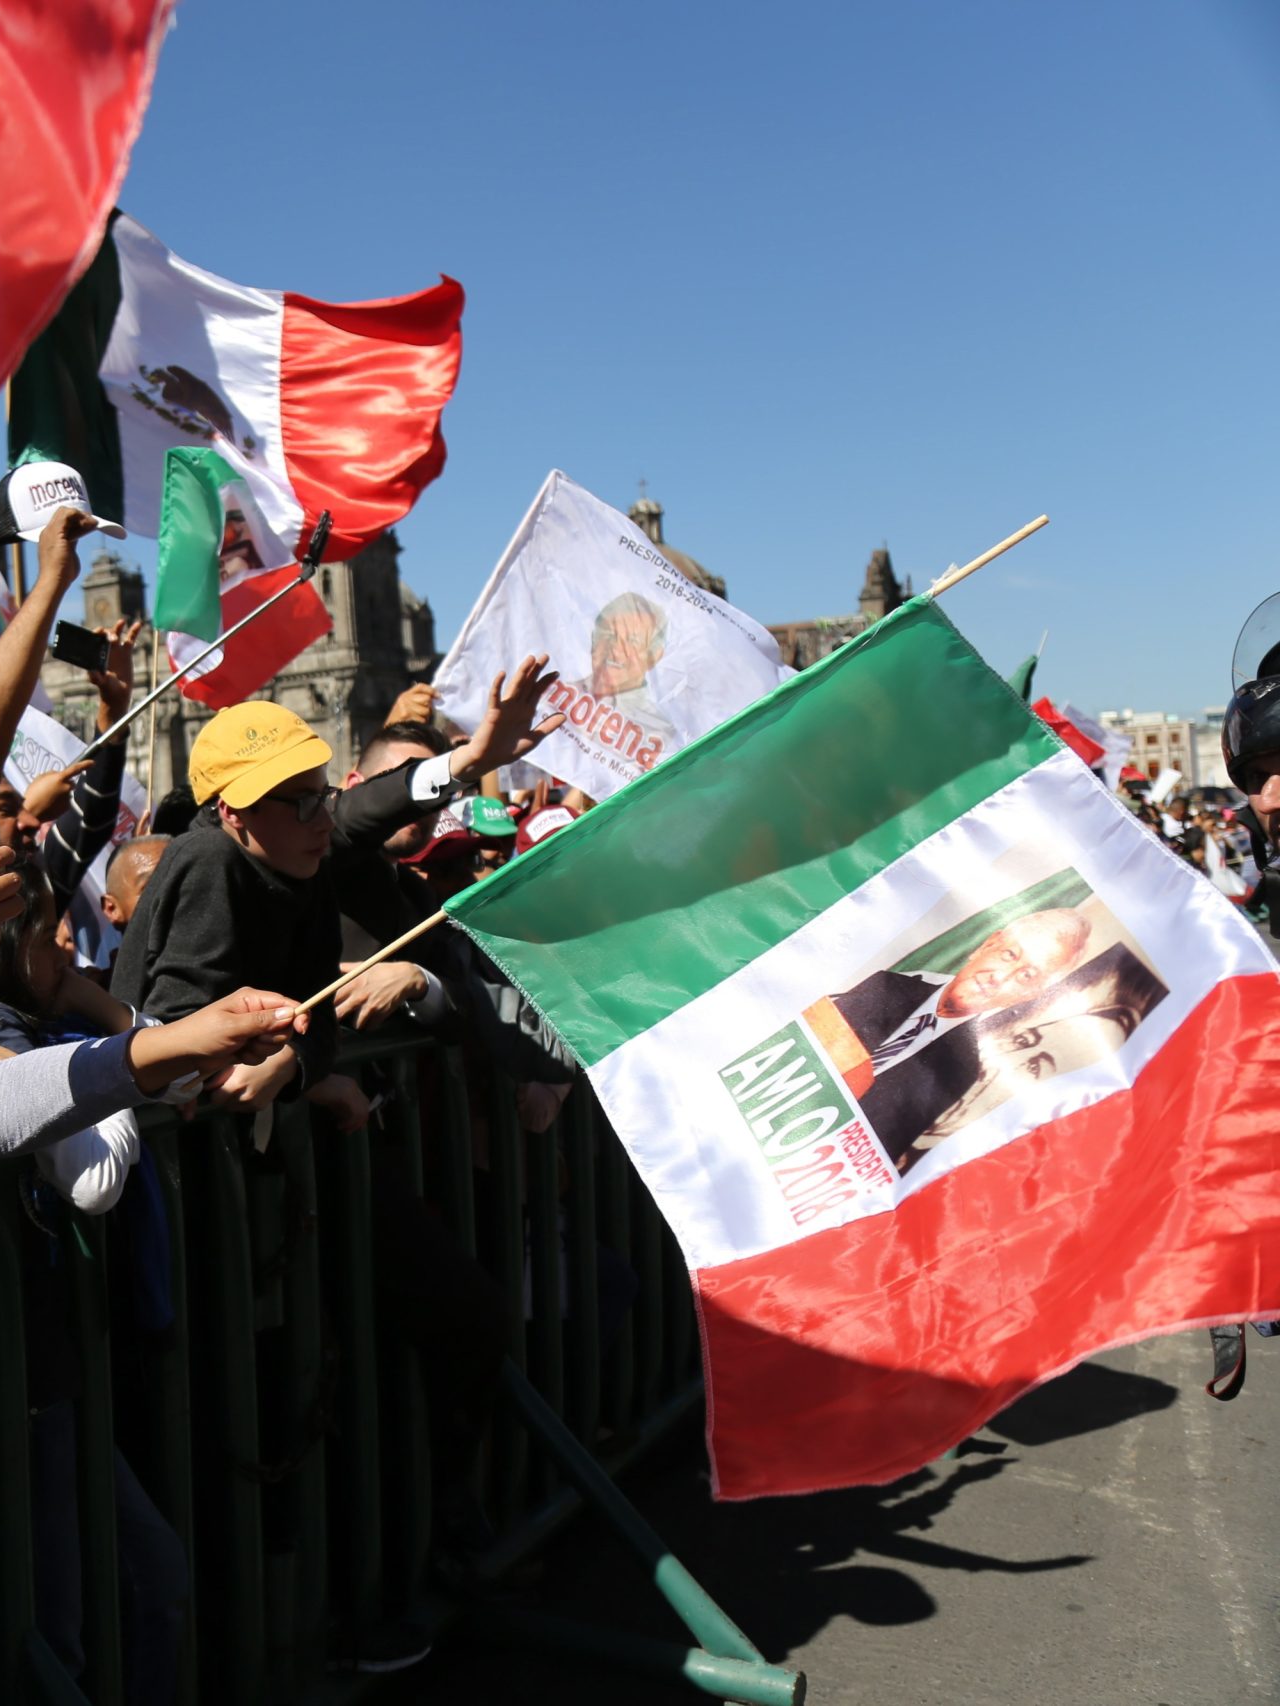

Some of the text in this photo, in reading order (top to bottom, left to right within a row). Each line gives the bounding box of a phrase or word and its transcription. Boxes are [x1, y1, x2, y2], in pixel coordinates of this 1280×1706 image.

[619, 535, 693, 588] PRESIDENTE
[546, 680, 664, 772] morena
[559, 724, 639, 783] eranza de Méxic
[721, 1038, 839, 1157] AMLO
[773, 1145, 858, 1226] 2018
[837, 1121, 894, 1192] PRESIDENTE
